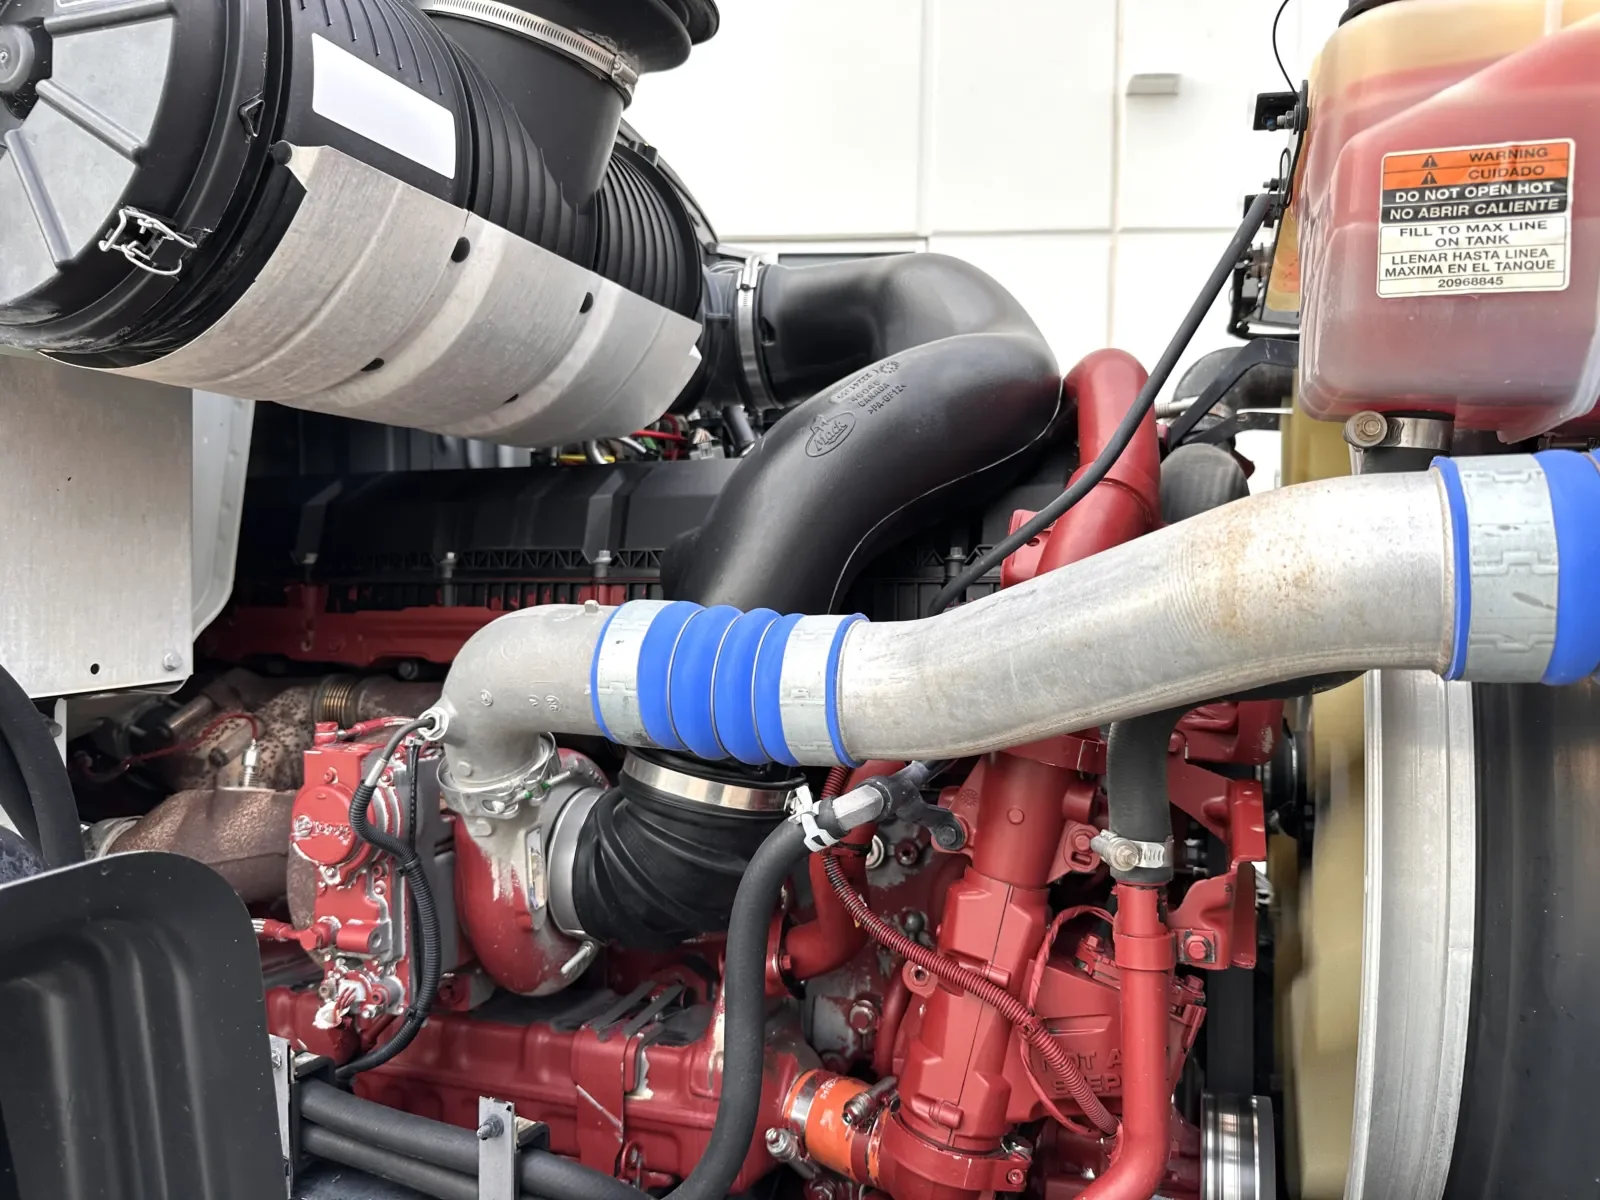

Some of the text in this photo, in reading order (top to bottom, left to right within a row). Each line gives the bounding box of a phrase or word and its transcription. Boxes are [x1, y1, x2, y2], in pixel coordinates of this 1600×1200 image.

[1469, 147, 1548, 162] WARNING
[1468, 166, 1545, 180] CUIDADO
[1395, 181, 1554, 203] DO NOT OPEN HOT
[1390, 199, 1559, 220] NO ABRIR CALIENTE
[1400, 220, 1548, 237] FILL TO MAX LINE
[1435, 235, 1510, 247] ON TANK
[1391, 248, 1549, 265] LLENAR HASTA LINEA
[1385, 260, 1556, 278] MAXIMA EN EL TANQUE
[1437, 276, 1504, 288] 20968845
[857, 382, 890, 408] CANADA
[813, 420, 849, 452] Mack
[1053, 1073, 1122, 1097] SEP
